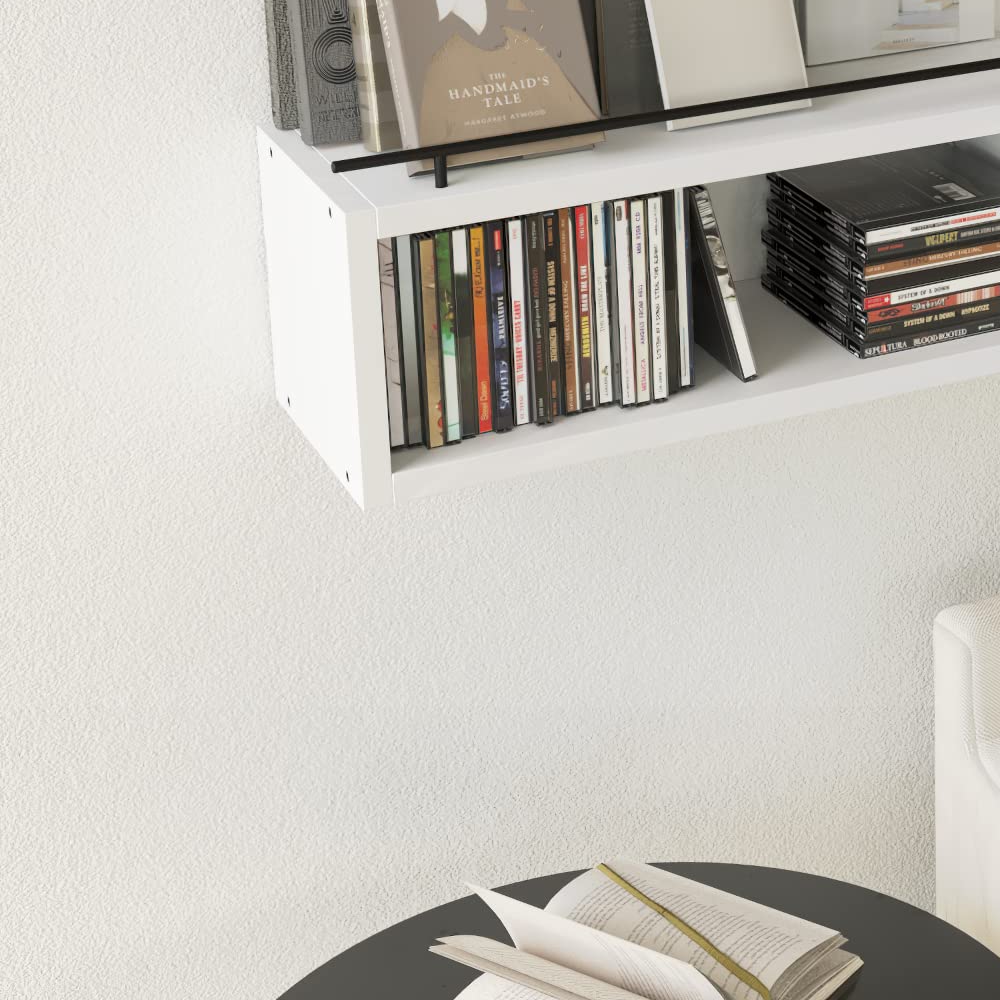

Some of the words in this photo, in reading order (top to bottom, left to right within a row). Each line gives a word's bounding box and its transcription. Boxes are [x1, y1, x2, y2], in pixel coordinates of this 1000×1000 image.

[489, 72, 506, 81] THE
[448, 76, 550, 100] HANDMAID'S
[484, 92, 522, 108] TALE
[464, 115, 506, 127] MARGARET
[510, 108, 546, 120] ATWOOD
[903, 315, 926, 328] SYSTEM
